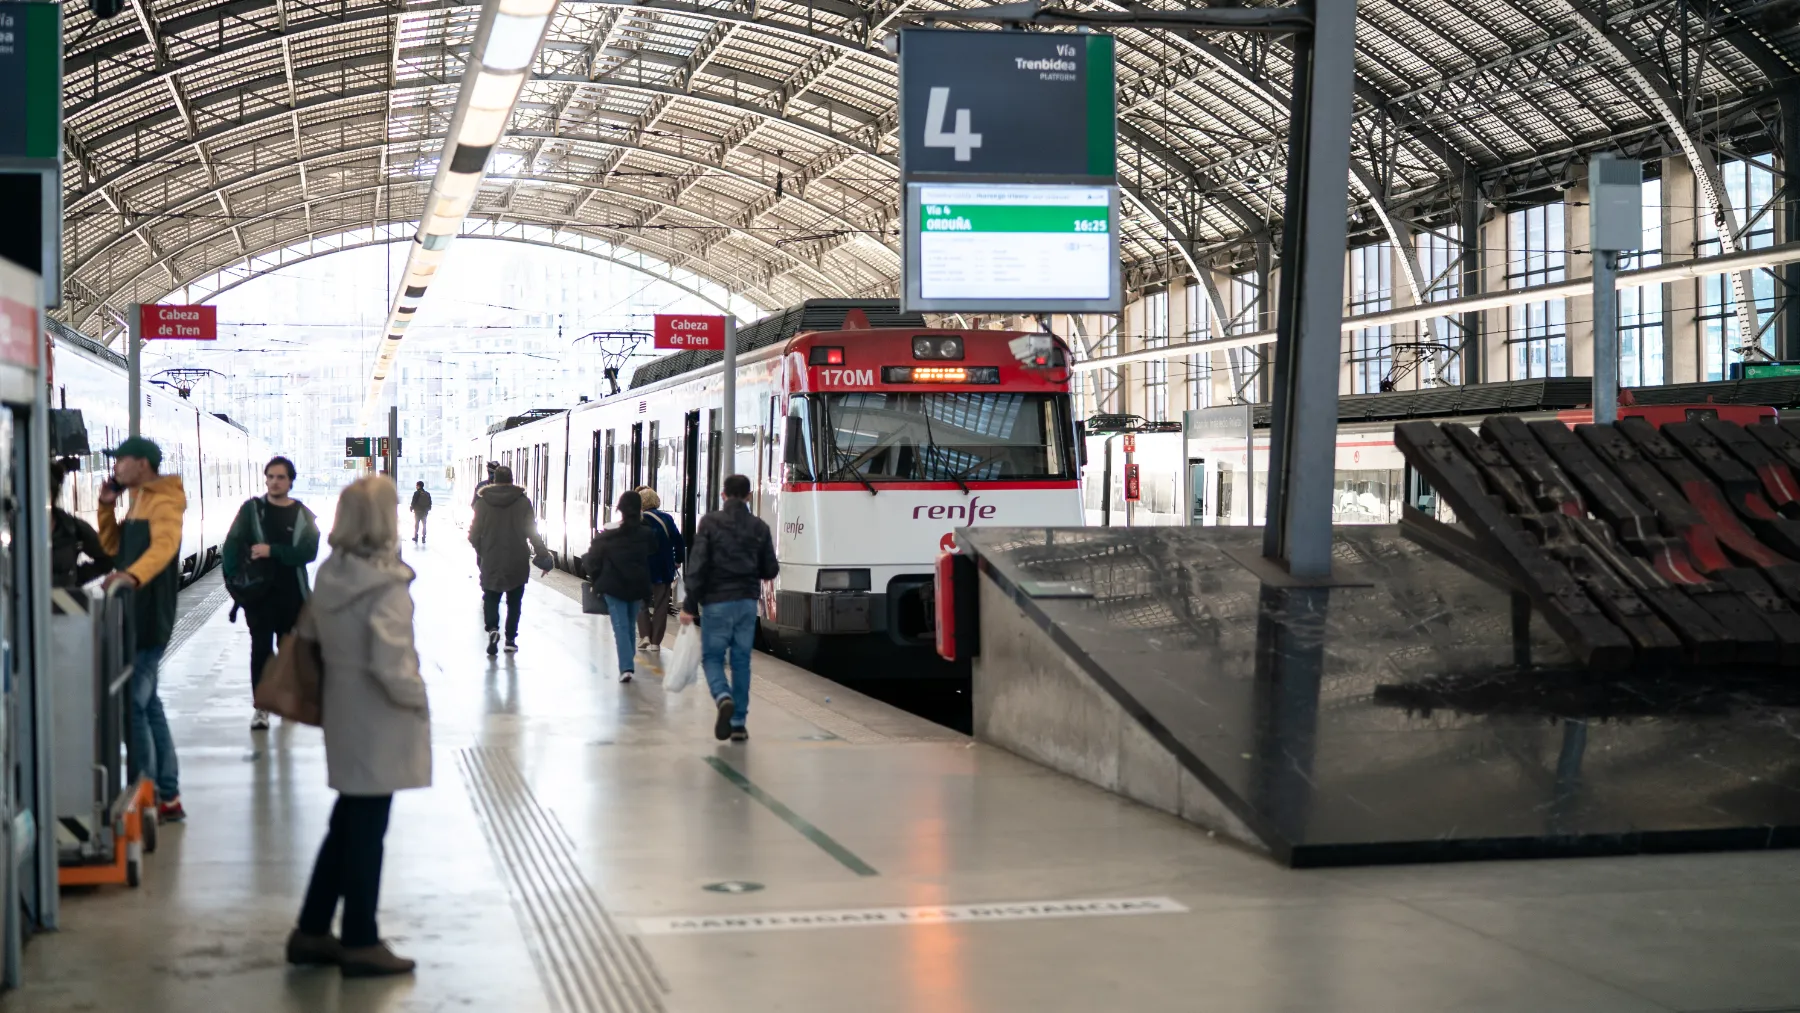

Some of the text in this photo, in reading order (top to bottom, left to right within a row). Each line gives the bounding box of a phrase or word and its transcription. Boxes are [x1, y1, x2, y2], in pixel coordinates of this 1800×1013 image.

[1056, 44, 1076, 57] Vía
[1015, 57, 1076, 71] Trenbidea
[1039, 73, 1076, 82] PLATFORM
[924, 86, 983, 162] 4
[943, 205, 951, 215] 4
[926, 216, 972, 231] ORDUÑA
[1073, 219, 1107, 232] 16:25
[158, 309, 200, 320] Cabeza
[158, 324, 200, 335] de Tren
[670, 319, 708, 331] Cabeza
[670, 333, 709, 345] de Tren
[821, 369, 874, 386] 170M
[347, 446, 353, 456] 5
[912, 495, 997, 527] renfe
[784, 516, 804, 540] renfe
